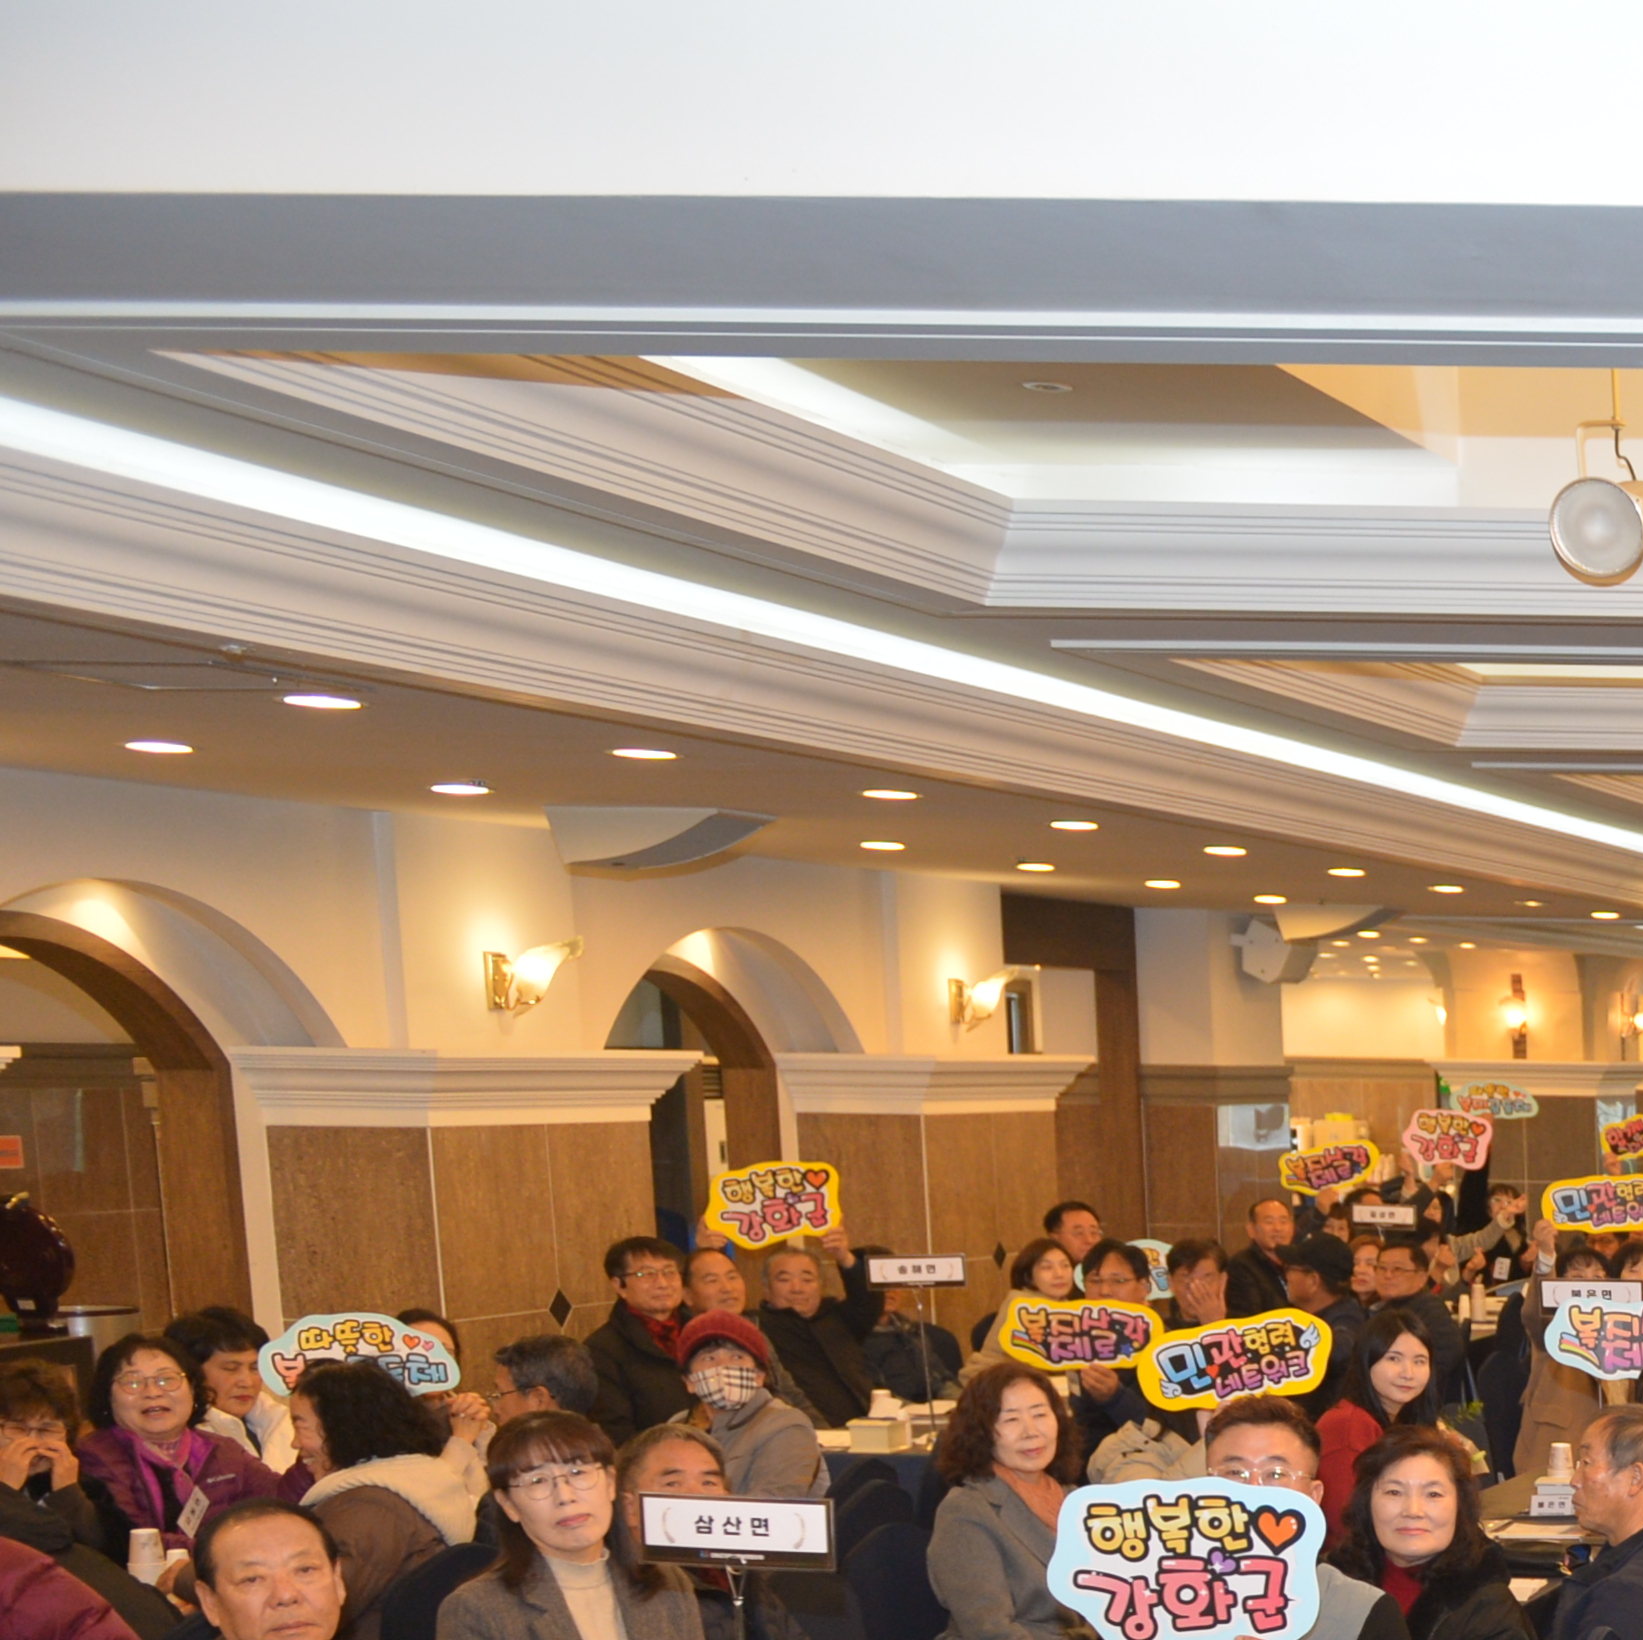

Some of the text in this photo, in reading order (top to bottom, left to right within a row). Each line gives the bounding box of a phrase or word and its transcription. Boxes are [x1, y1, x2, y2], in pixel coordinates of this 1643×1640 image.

[722, 1167, 805, 1204] 행복한
[721, 1192, 828, 1242] 강화군
[297, 1319, 395, 1355] 따뜻한
[1017, 1306, 1152, 1345] 복지사각
[1049, 1329, 1118, 1363] 제로
[1215, 1350, 1310, 1399] 네트워크
[694, 1515, 770, 1537] 삼산면
[1083, 1493, 1253, 1561] 행복한
